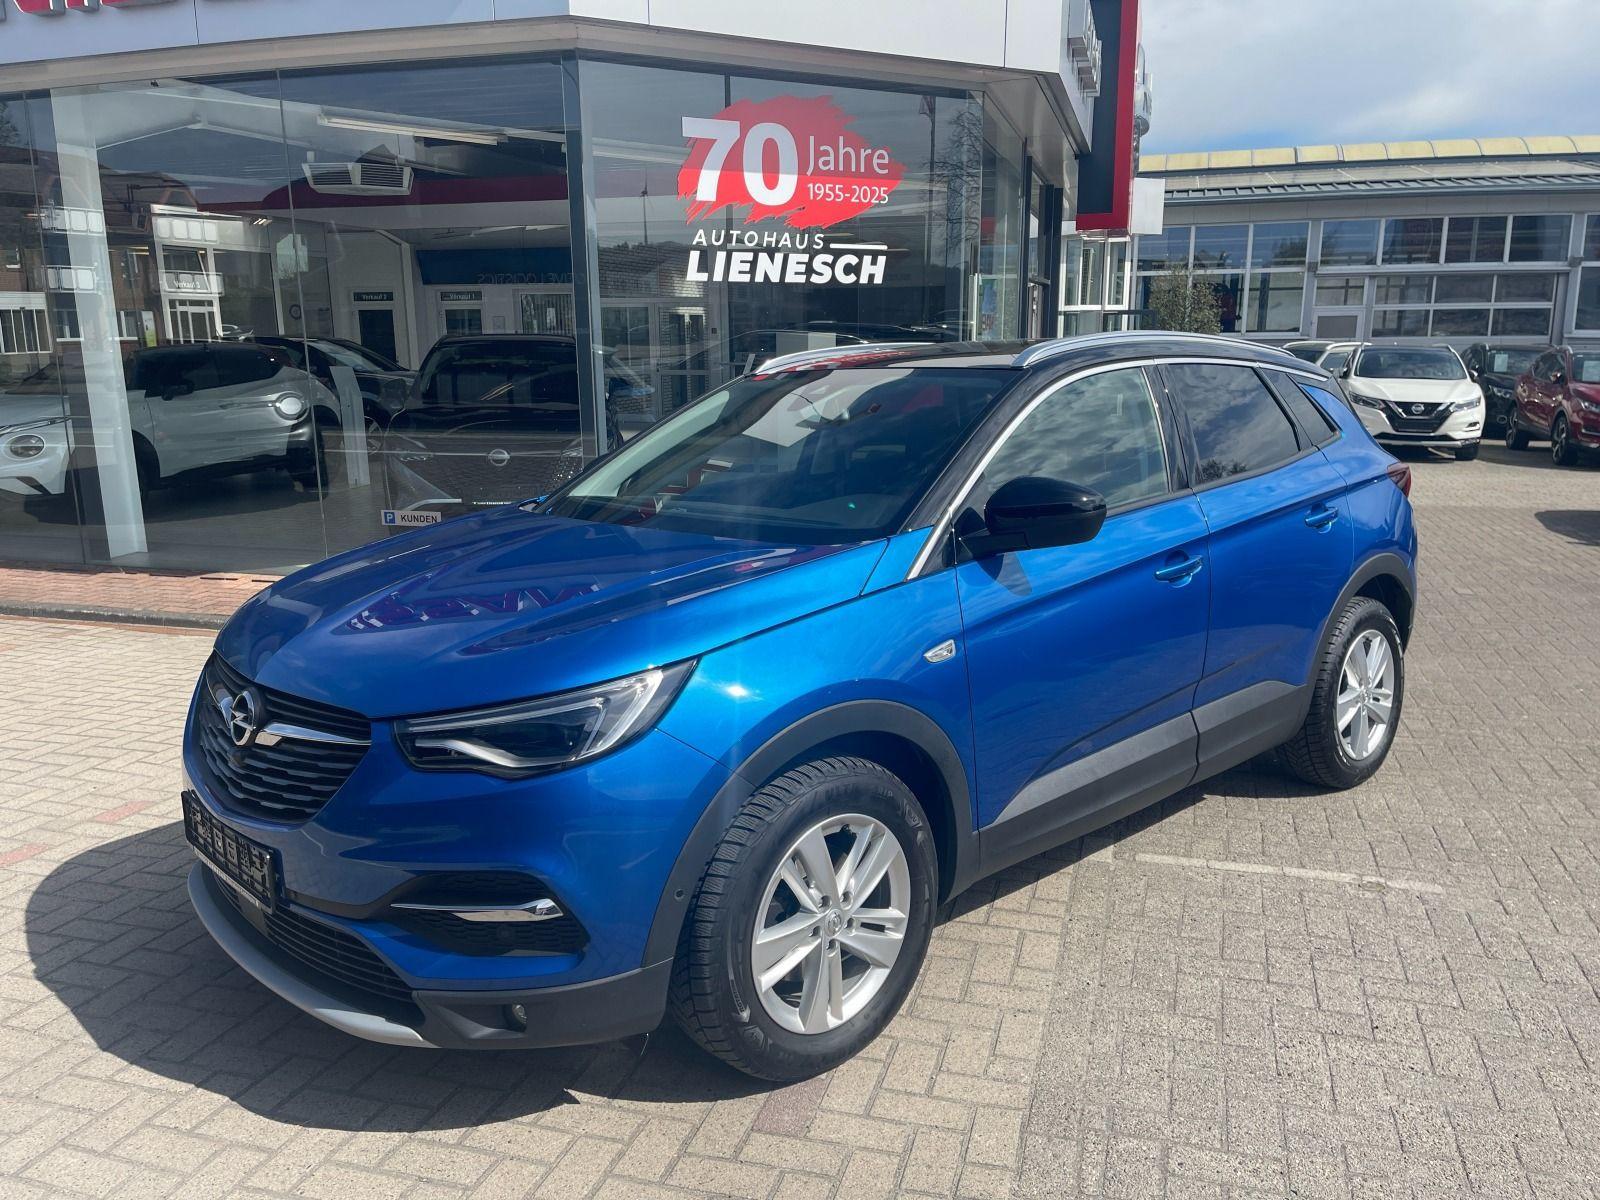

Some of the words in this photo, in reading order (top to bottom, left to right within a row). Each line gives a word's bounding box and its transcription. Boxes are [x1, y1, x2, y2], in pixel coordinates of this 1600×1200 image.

[681, 116, 799, 206] 70
[806, 135, 889, 176] Jahre
[807, 183, 889, 204] 1955-2025
[692, 229, 825, 249] AUTOHAUS
[686, 250, 887, 285] LIENESCH
[400, 514, 438, 523] KUNDEN
